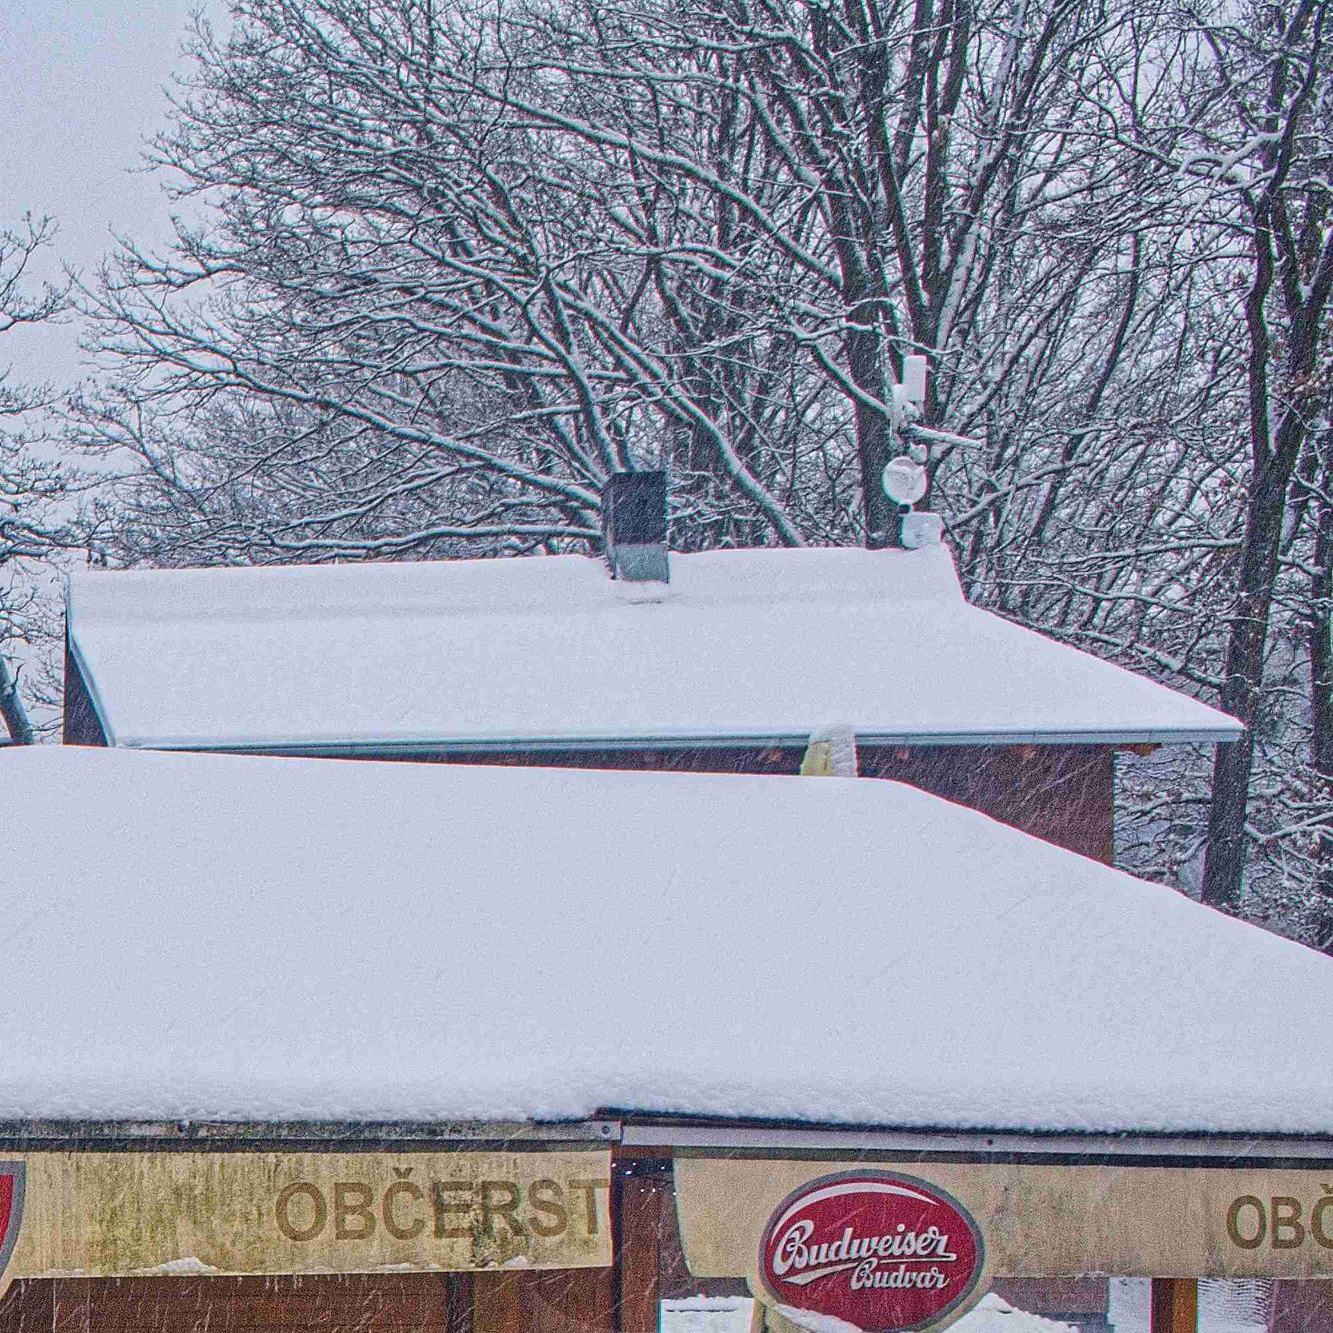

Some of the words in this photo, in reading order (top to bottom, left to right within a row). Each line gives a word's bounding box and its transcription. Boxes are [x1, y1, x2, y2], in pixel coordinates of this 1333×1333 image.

[275, 1167, 610, 1242] OBČERST
[773, 1219, 957, 1276] Budweiser
[850, 1259, 951, 1290] Budvar
